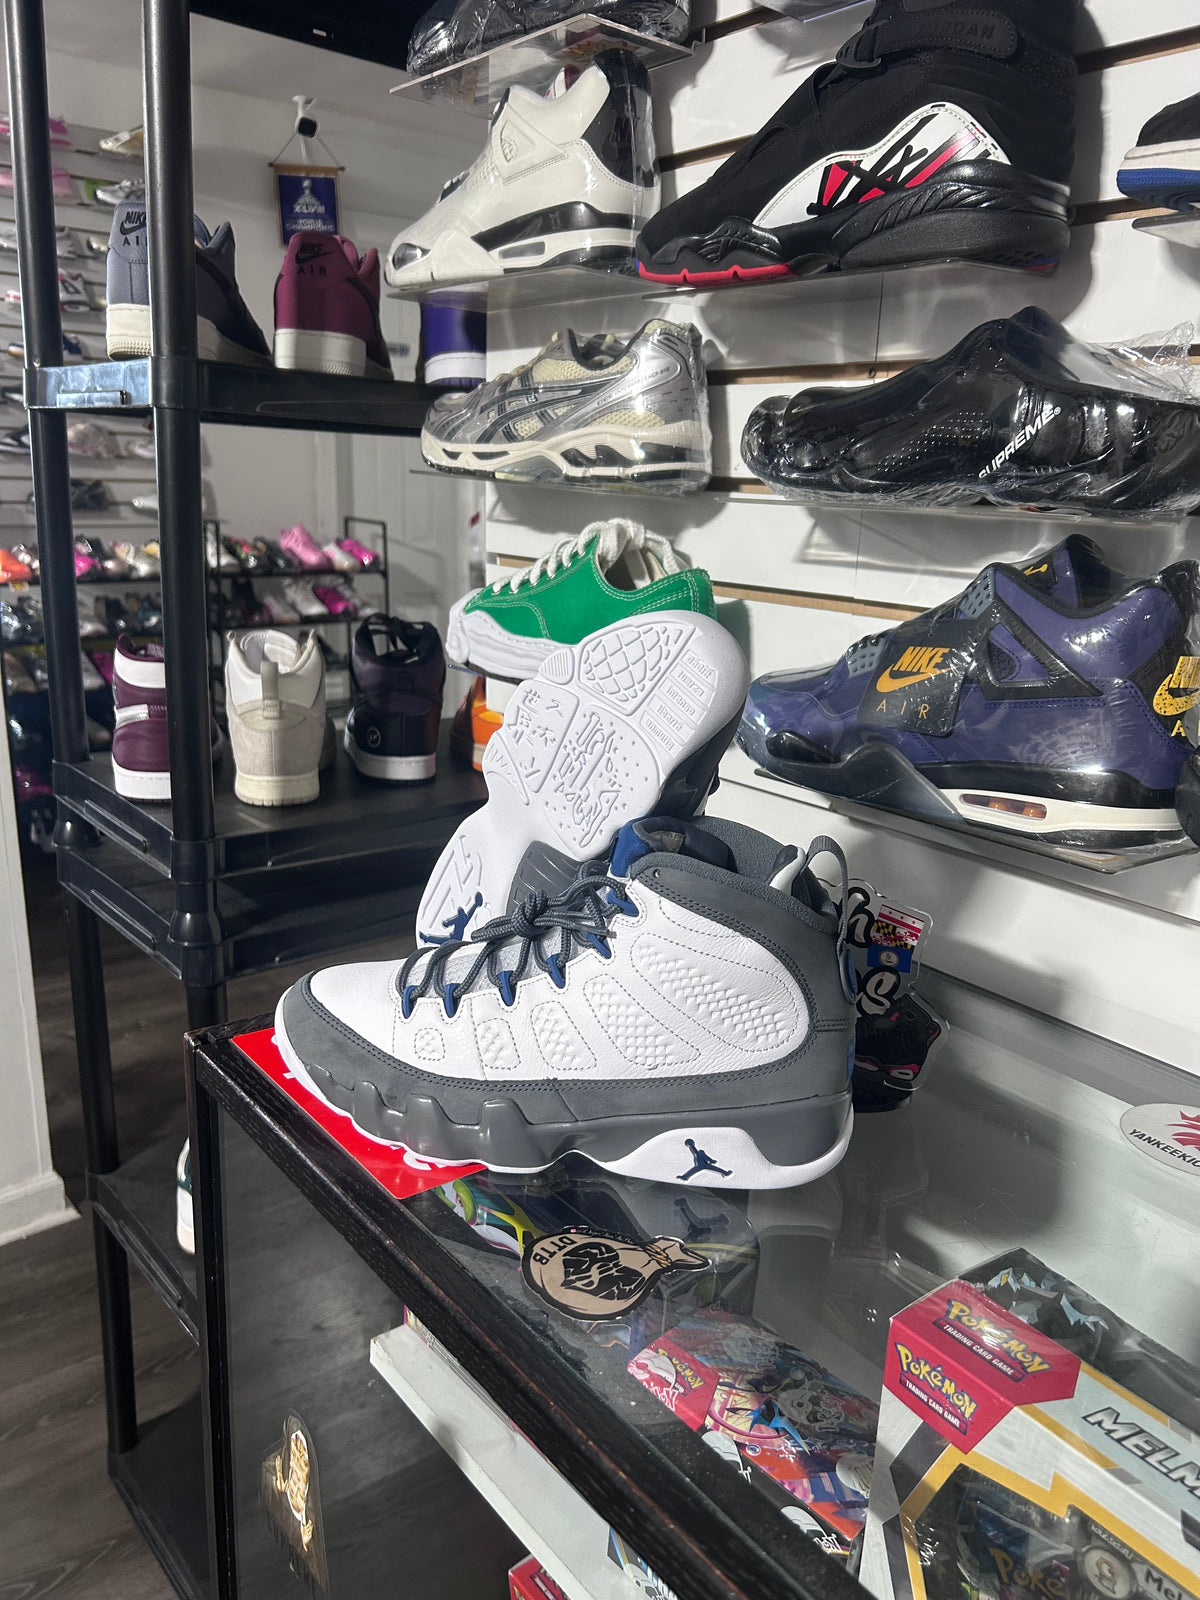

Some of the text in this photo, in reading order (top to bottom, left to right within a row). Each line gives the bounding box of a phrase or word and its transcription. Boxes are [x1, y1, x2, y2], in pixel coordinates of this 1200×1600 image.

[123, 235, 148, 247] AI
[300, 241, 325, 255] NIKE
[299, 265, 327, 277] AIR
[892, 646, 950, 674] NIKE
[875, 698, 929, 720] AIR
[532, 1235, 578, 1267] DTTB
[942, 1323, 1016, 1377] TRADING CARD GAME
[905, 1379, 962, 1429] TRADING CARD GAME
